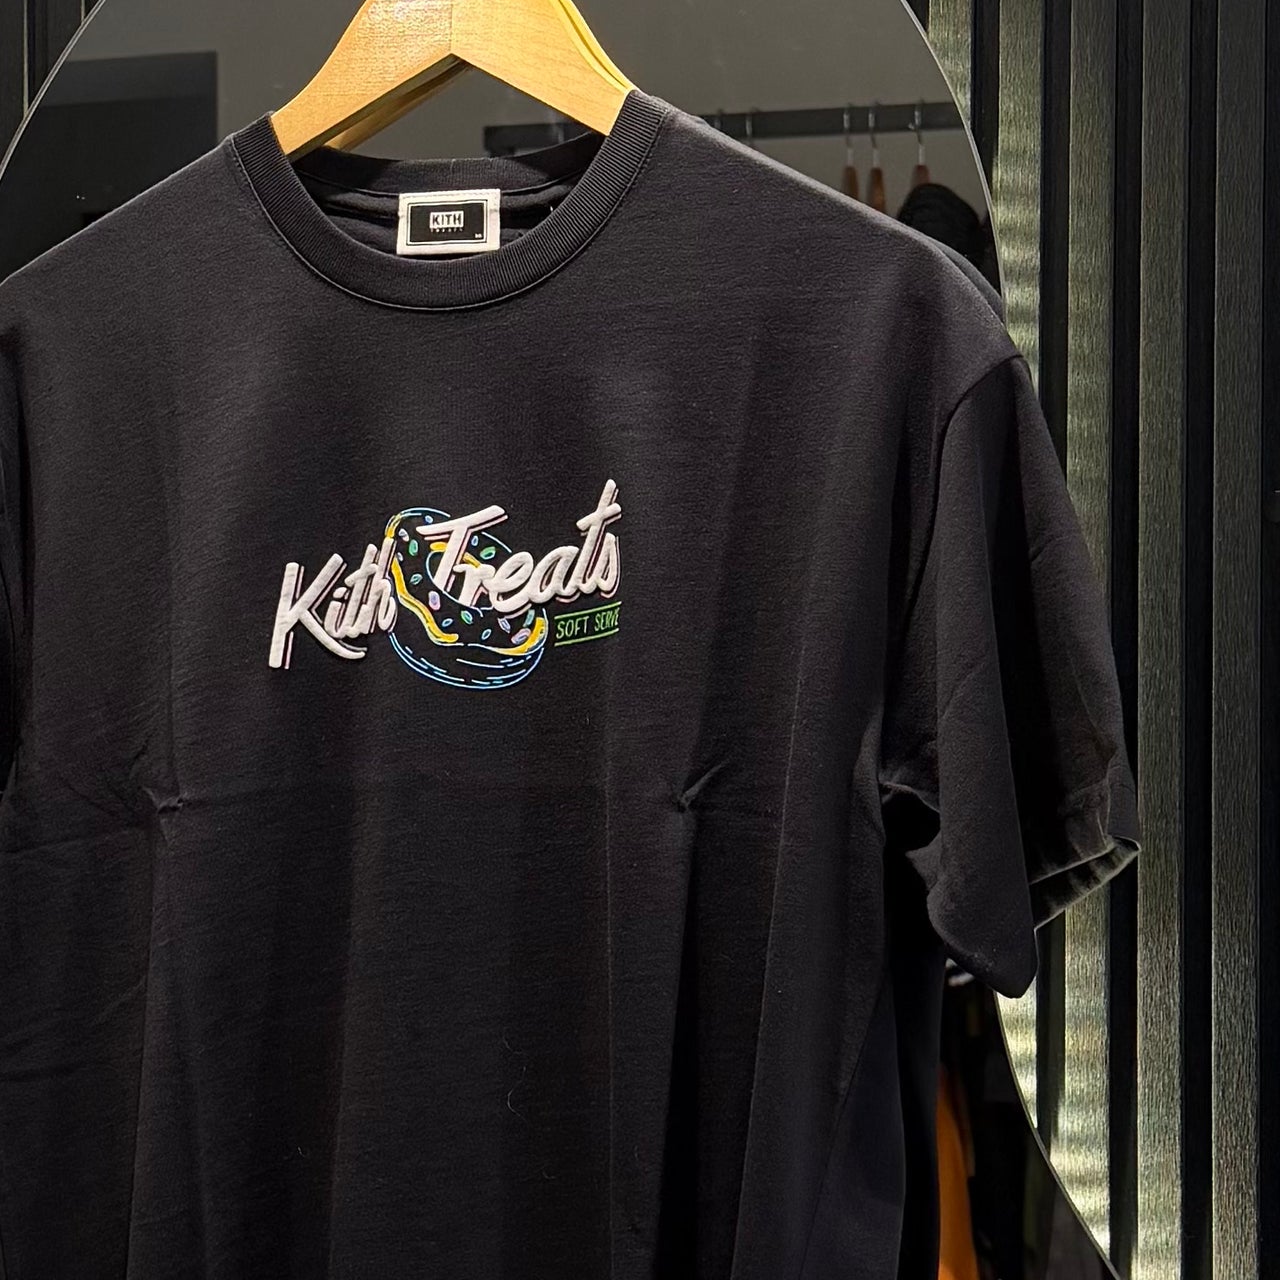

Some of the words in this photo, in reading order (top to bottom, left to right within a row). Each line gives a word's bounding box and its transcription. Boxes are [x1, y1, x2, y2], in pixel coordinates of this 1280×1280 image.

[433, 213, 462, 226] KITH
[269, 537, 398, 669] Kith
[416, 479, 622, 613] Treats
[556, 616, 590, 639] SOFT
